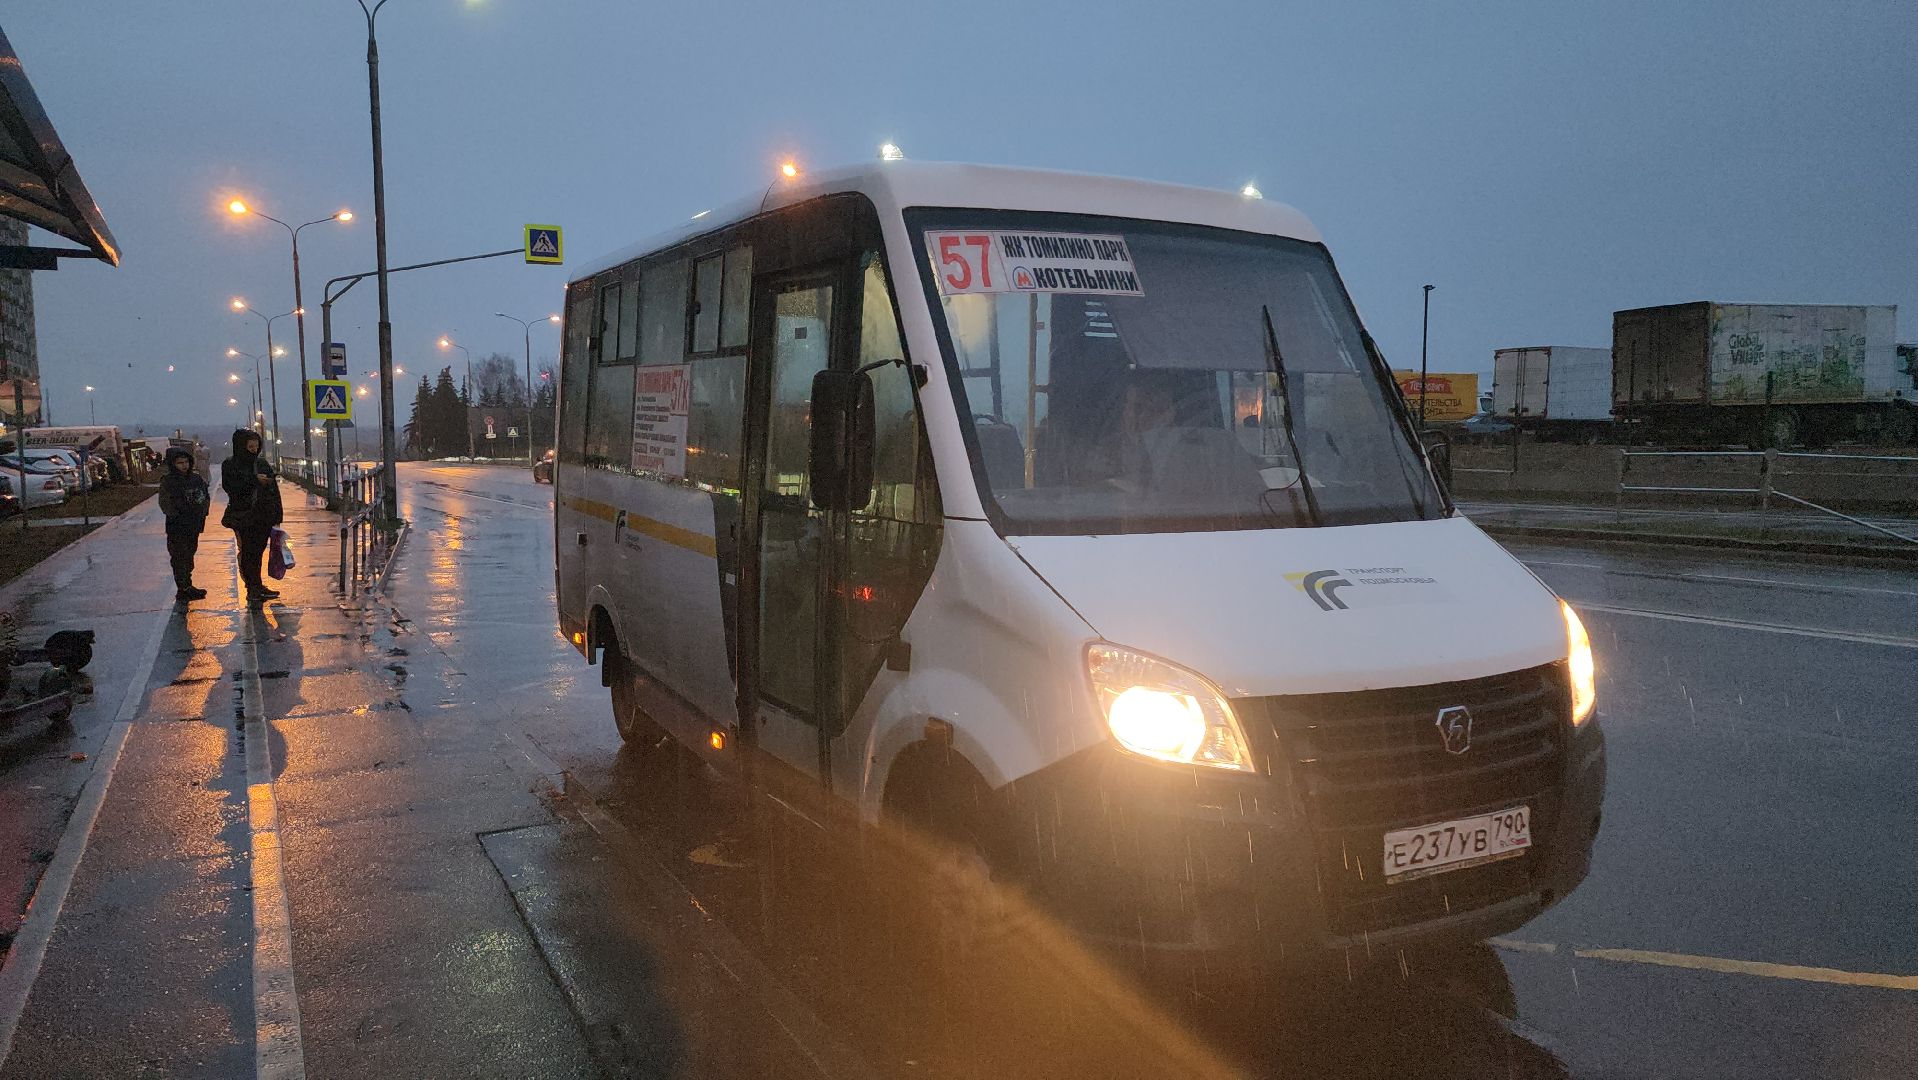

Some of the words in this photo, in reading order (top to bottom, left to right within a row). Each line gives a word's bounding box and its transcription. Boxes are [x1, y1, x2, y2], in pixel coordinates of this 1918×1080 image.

[939, 235, 991, 290] 57
[1001, 235, 1022, 258] ЖК
[1023, 236, 1095, 261] ТОМИЛИНО
[1095, 240, 1129, 262] ПАРК
[1033, 267, 1140, 292] КОТЕЛЬНИКИ
[1493, 811, 1523, 840] 790
